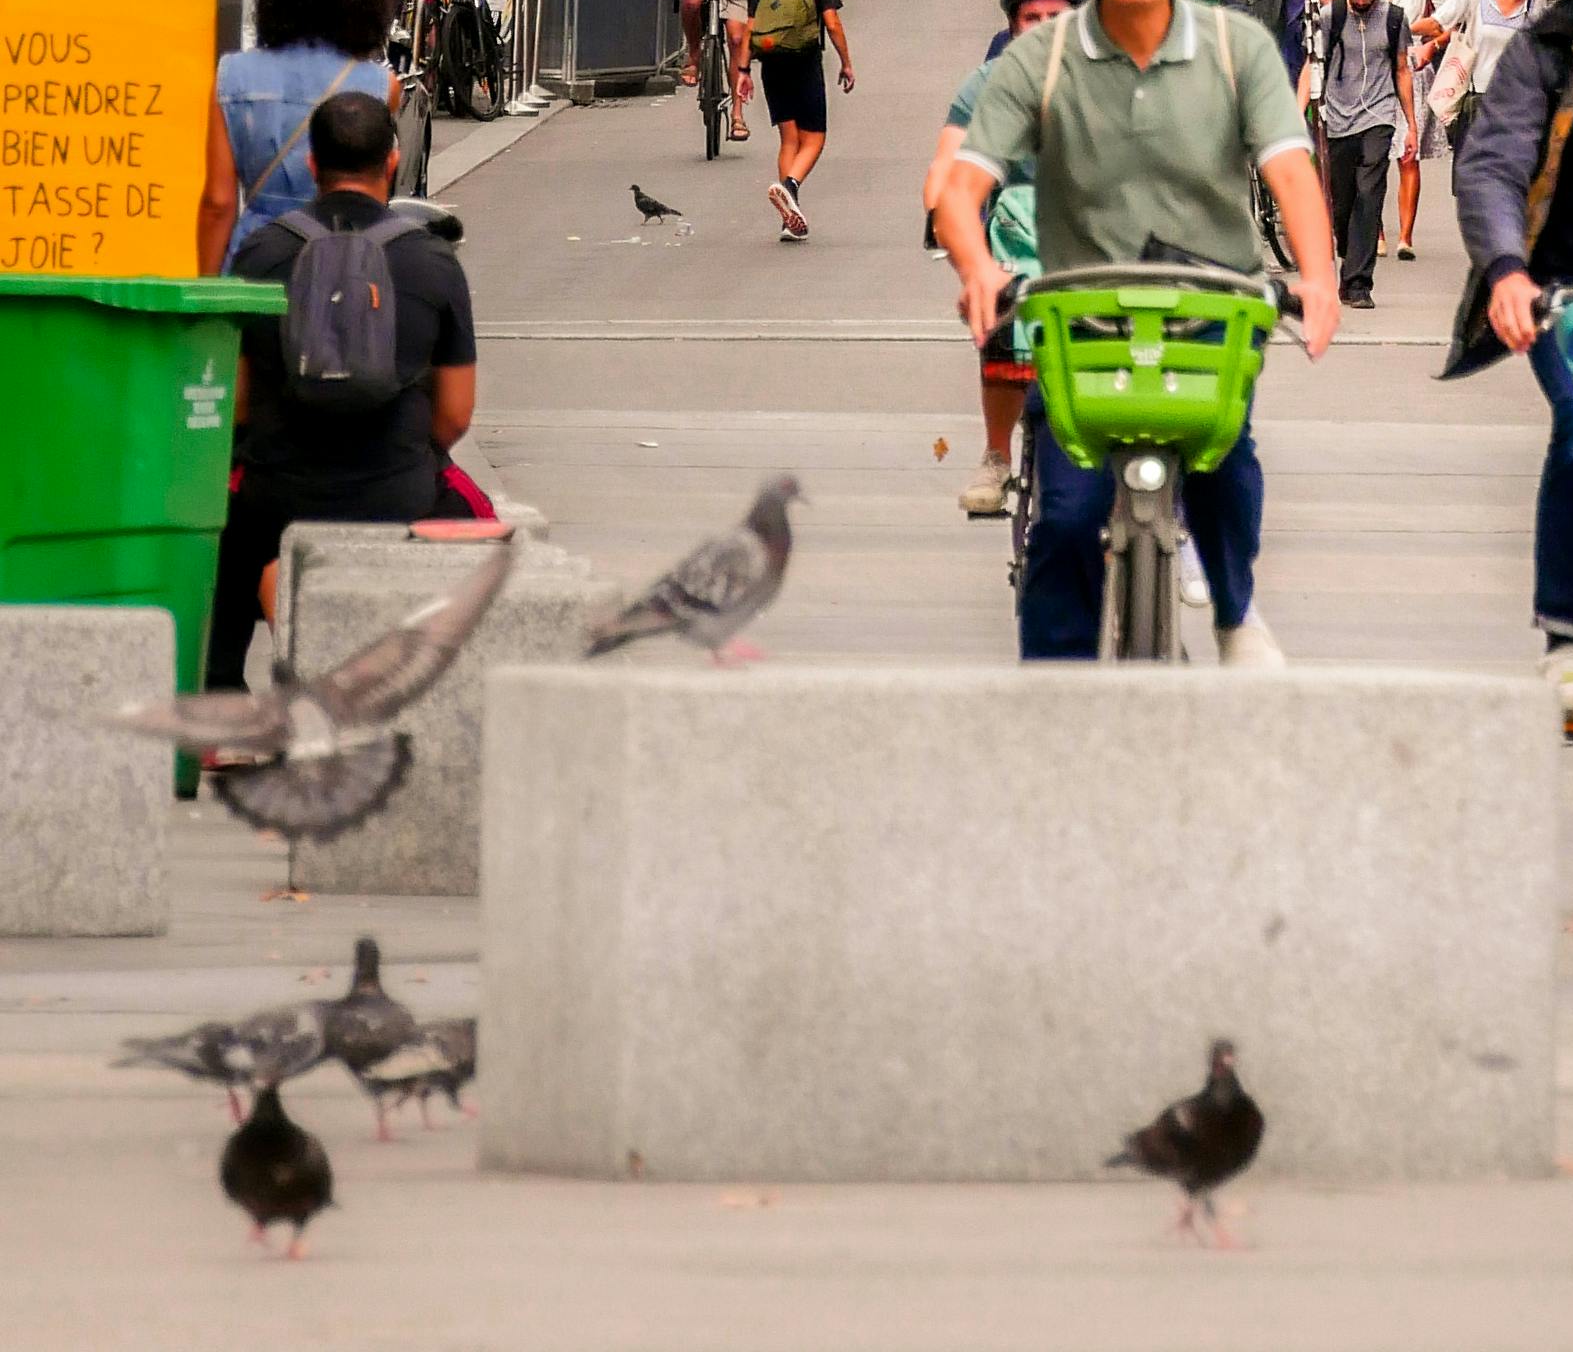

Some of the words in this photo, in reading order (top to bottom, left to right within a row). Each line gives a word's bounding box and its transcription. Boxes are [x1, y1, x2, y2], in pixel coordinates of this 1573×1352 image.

[5, 32, 92, 66] VOUS
[3, 81, 164, 116] PRENDREZ
[83, 132, 145, 168] UNE
[3, 182, 113, 218] TASSE
[126, 183, 165, 219] DE
[92, 232, 104, 265] ?
